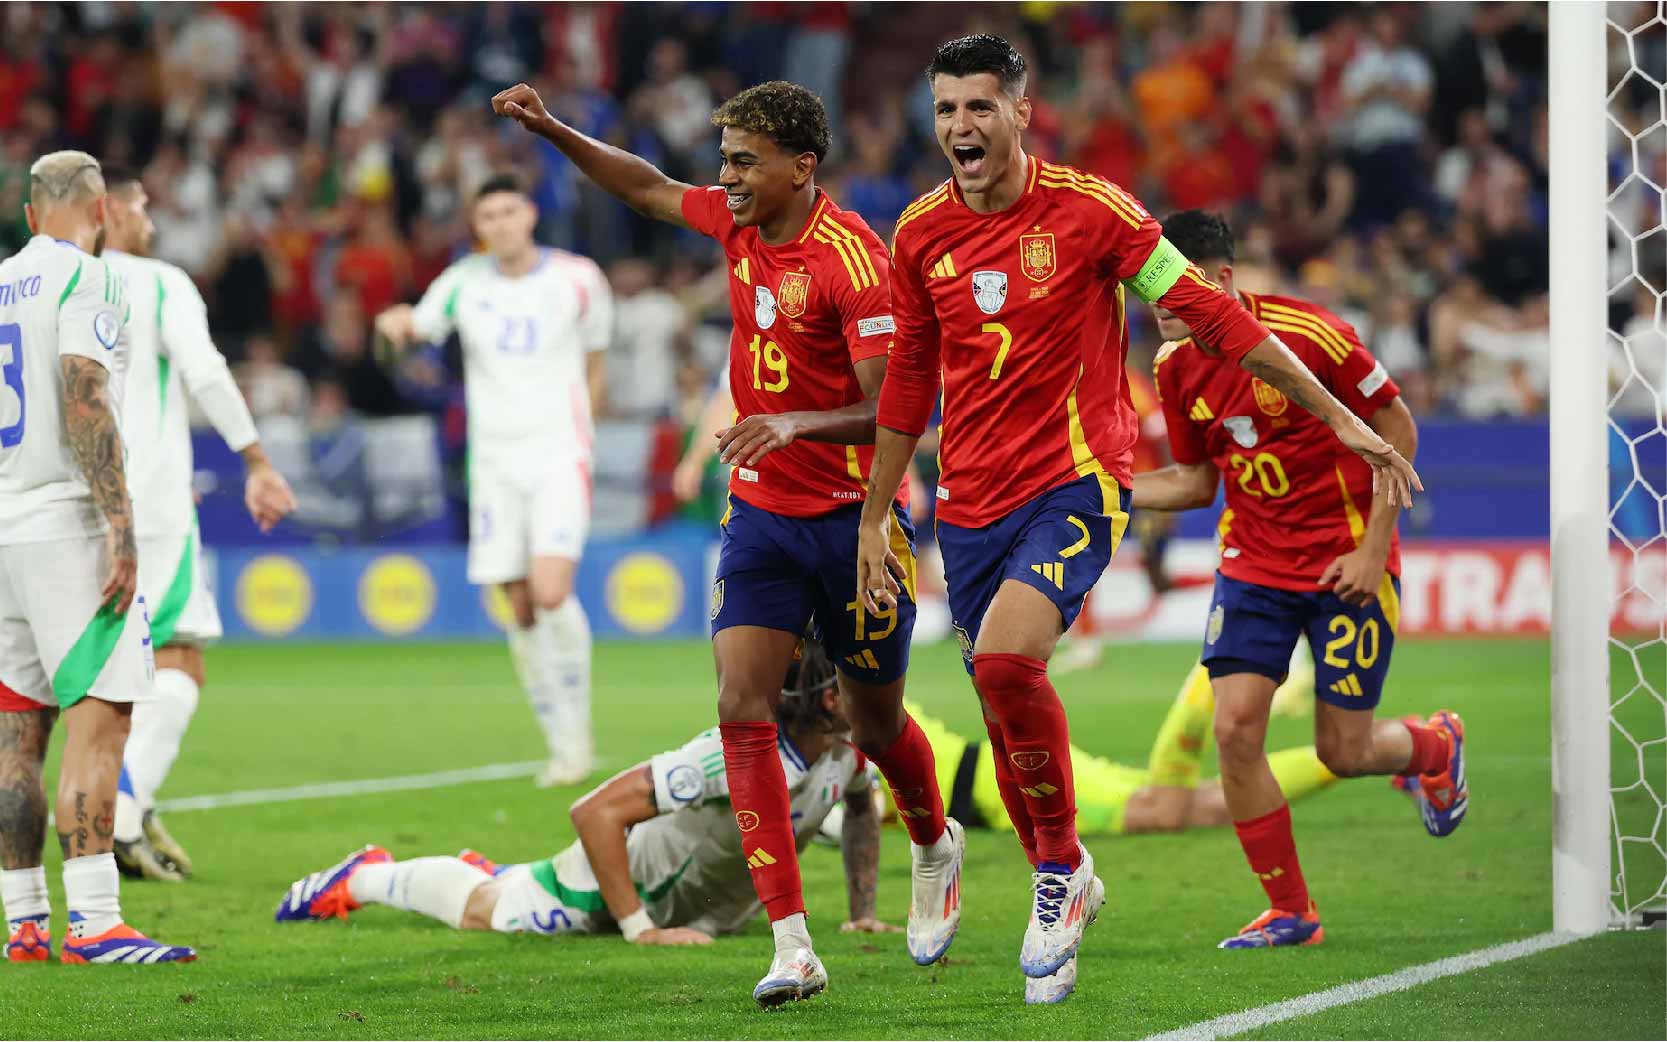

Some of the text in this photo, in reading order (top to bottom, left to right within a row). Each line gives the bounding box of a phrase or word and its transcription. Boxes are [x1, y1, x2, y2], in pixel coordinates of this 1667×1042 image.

[499, 316, 540, 354] 23
[981, 322, 1012, 380] 7
[749, 333, 790, 394] 19
[1230, 452, 1289, 498] 20
[1058, 514, 1091, 559] 7
[847, 591, 898, 641] 19
[1323, 614, 1379, 670] 20
